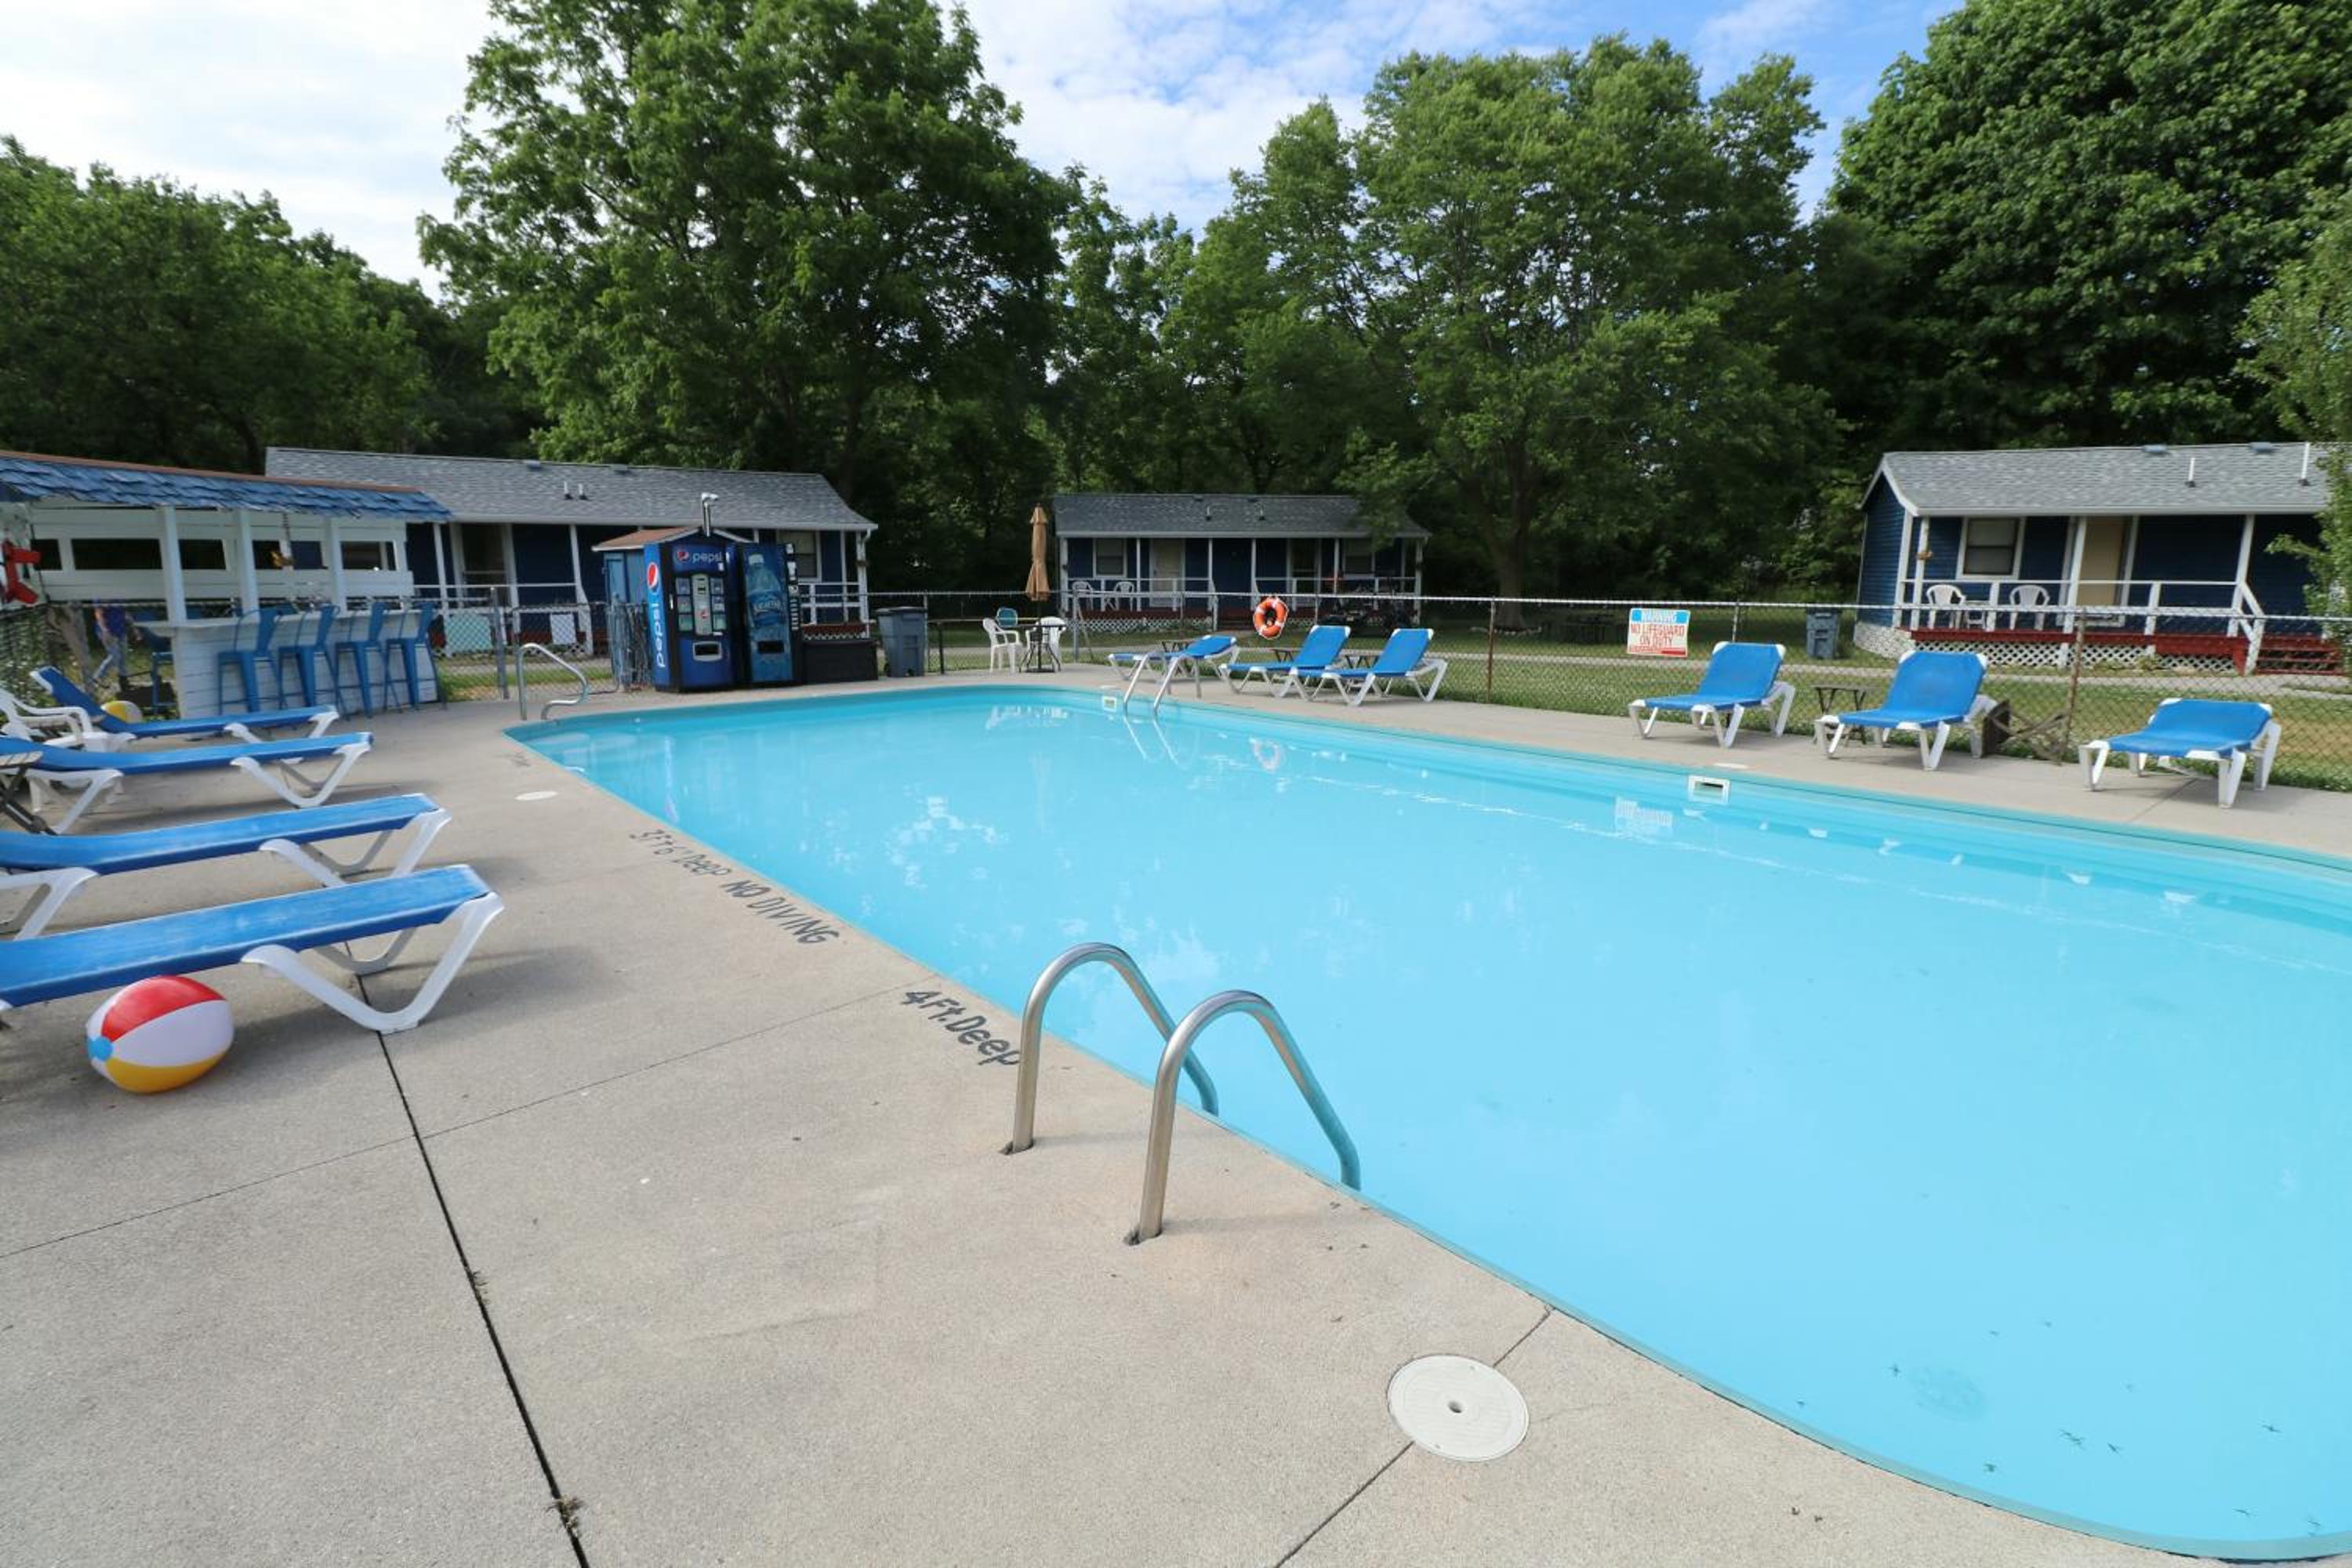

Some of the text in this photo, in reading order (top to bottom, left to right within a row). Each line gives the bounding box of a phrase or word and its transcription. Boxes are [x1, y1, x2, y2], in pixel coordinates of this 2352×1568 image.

[691, 551, 723, 564] pepsi
[652, 602, 666, 668] pepsi
[718, 879, 771, 898] NO
[746, 896, 840, 944] DIVING
